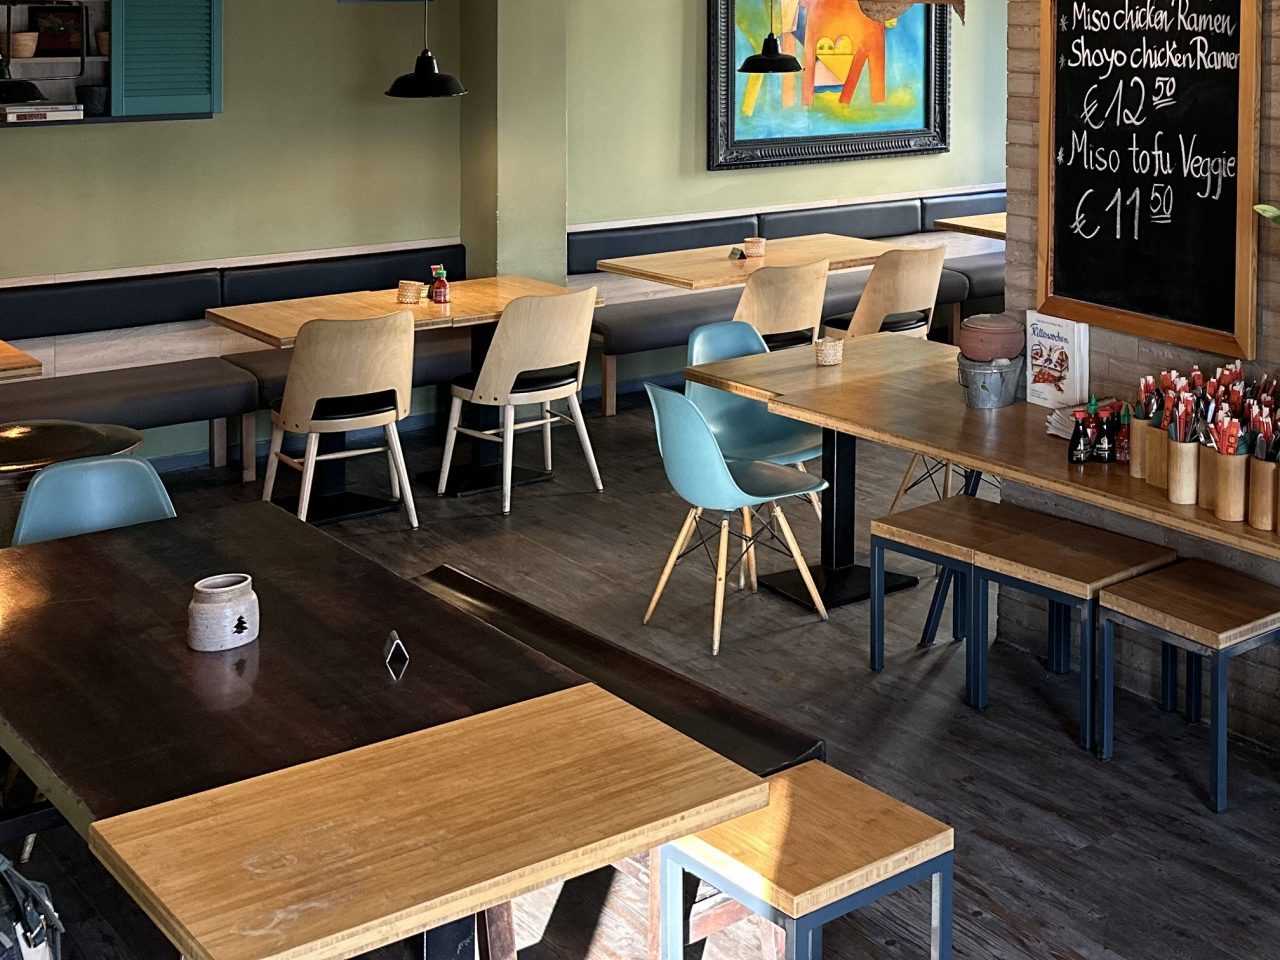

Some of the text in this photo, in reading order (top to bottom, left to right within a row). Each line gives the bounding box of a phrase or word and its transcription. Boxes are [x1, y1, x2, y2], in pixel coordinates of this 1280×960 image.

[1072, 1, 1111, 33] Miso
[1067, 34, 1128, 80] Shoyo
[1130, 35, 1196, 70] chicken
[1067, 129, 1237, 201] Miso tofu Veggie
